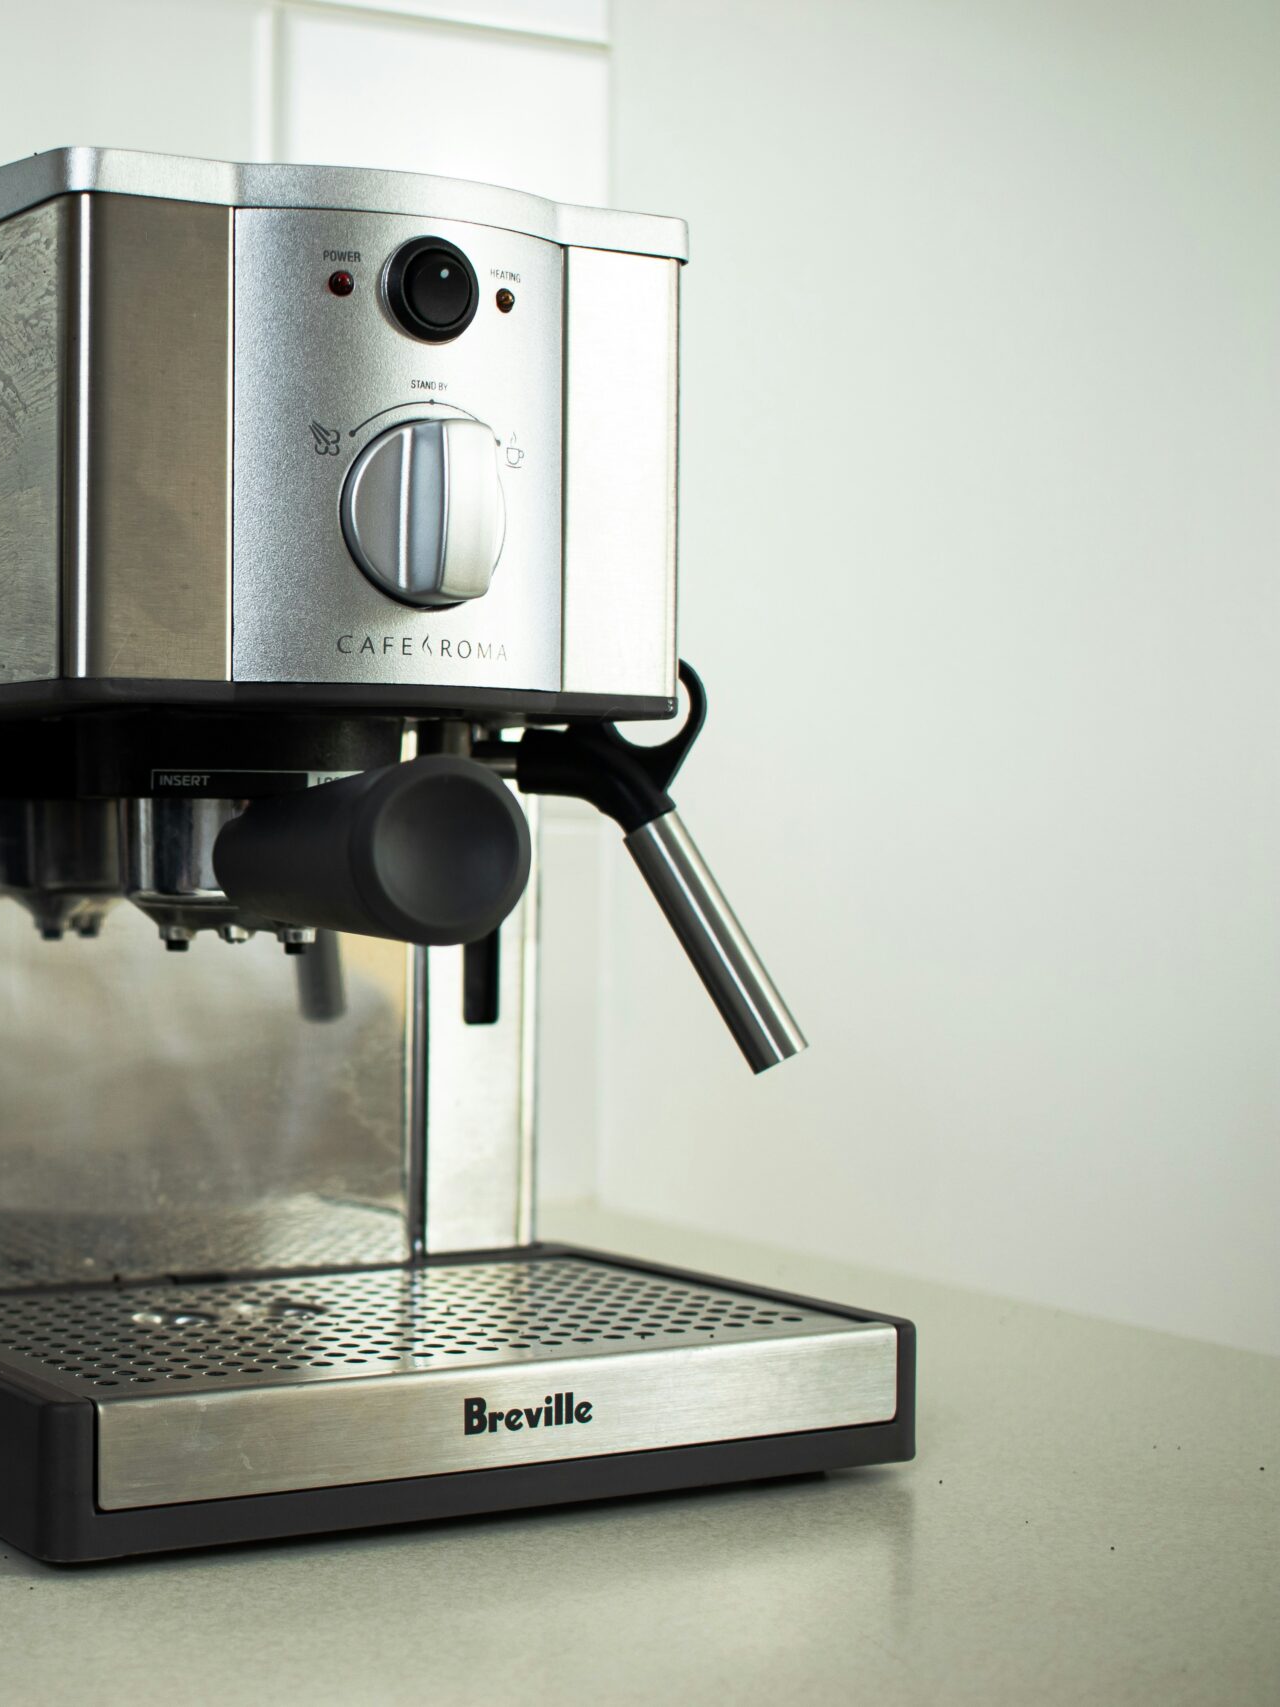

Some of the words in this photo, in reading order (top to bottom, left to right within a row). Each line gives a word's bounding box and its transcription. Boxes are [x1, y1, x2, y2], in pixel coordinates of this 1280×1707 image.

[323, 250, 362, 263] POWER
[490, 268, 521, 284] HEATING
[411, 379, 437, 391] STAND
[438, 381, 449, 392] BY
[337, 634, 413, 656] CAFE
[440, 639, 508, 662] ROMA
[159, 775, 211, 787] INSERT
[464, 1391, 593, 1436] Breville
